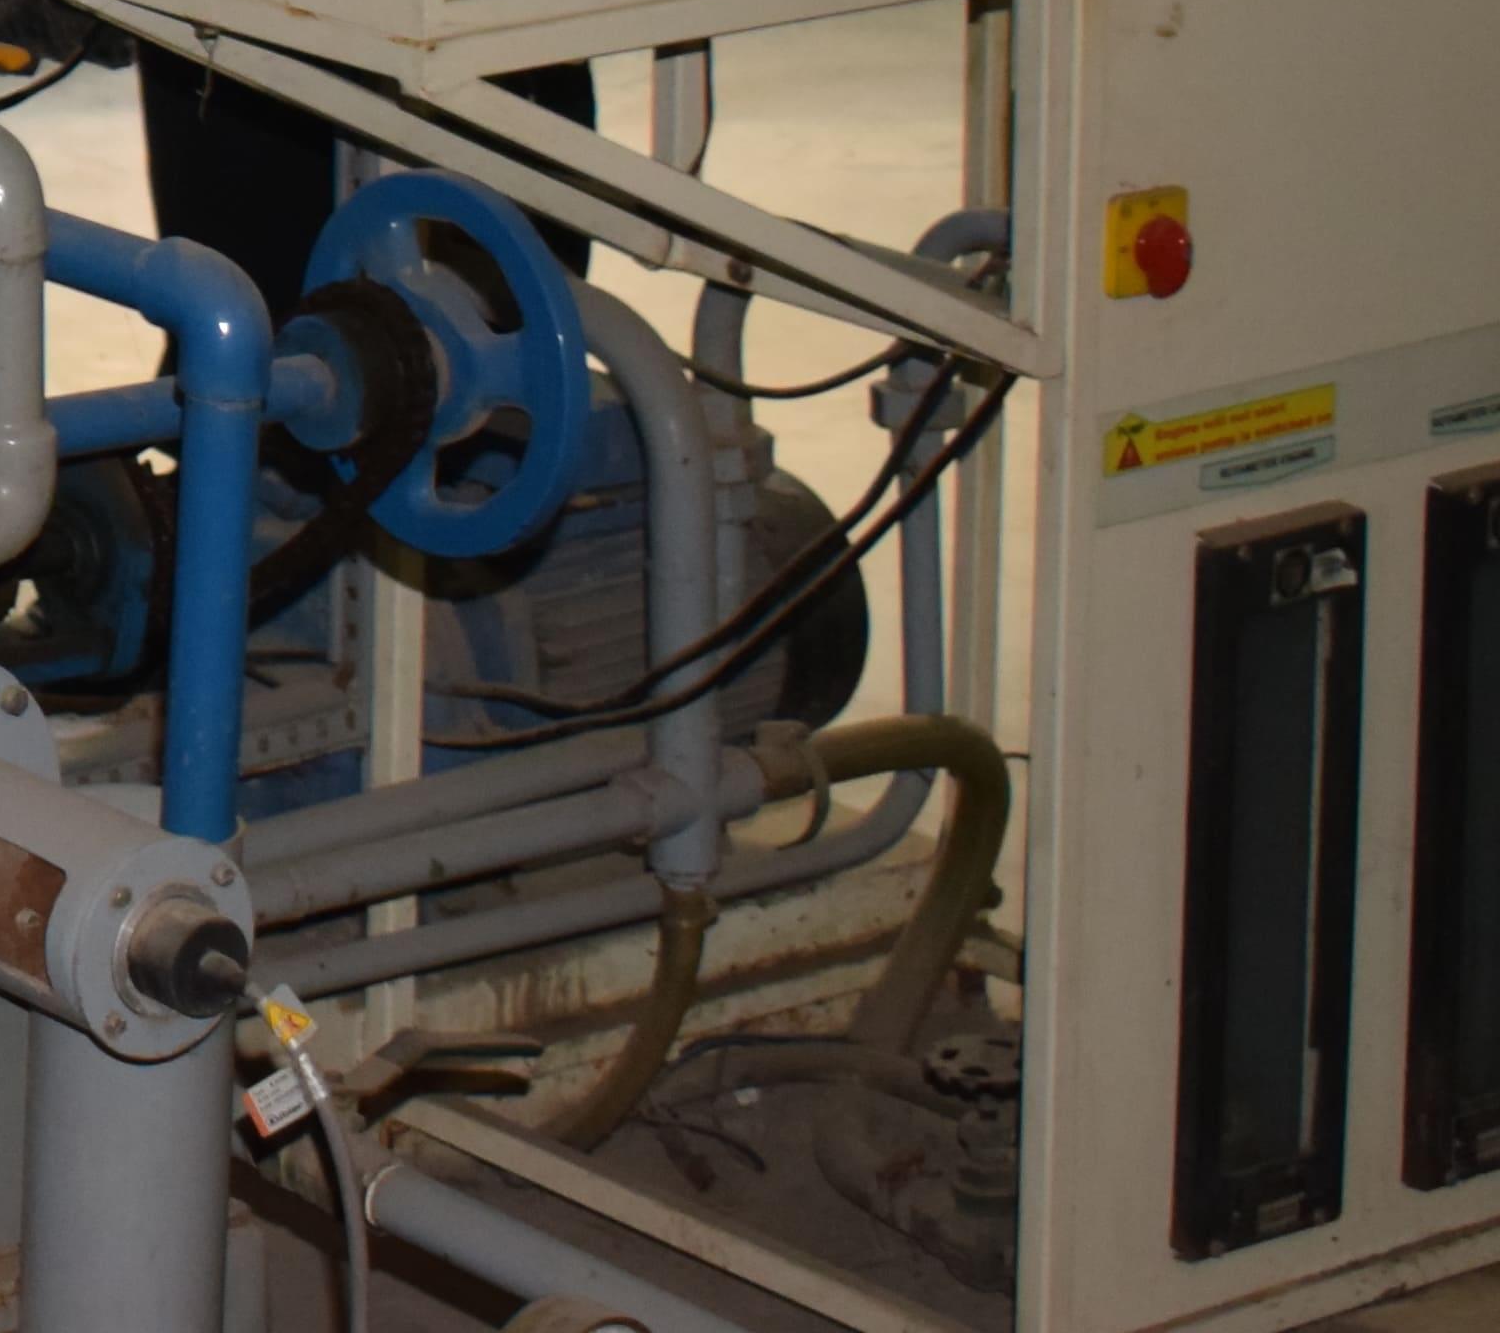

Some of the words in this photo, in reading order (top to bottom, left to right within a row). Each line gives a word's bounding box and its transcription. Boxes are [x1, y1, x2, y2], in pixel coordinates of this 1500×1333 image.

[1155, 424, 1199, 442] Engine
[1203, 415, 1226, 430] will
[1229, 410, 1251, 424] not
